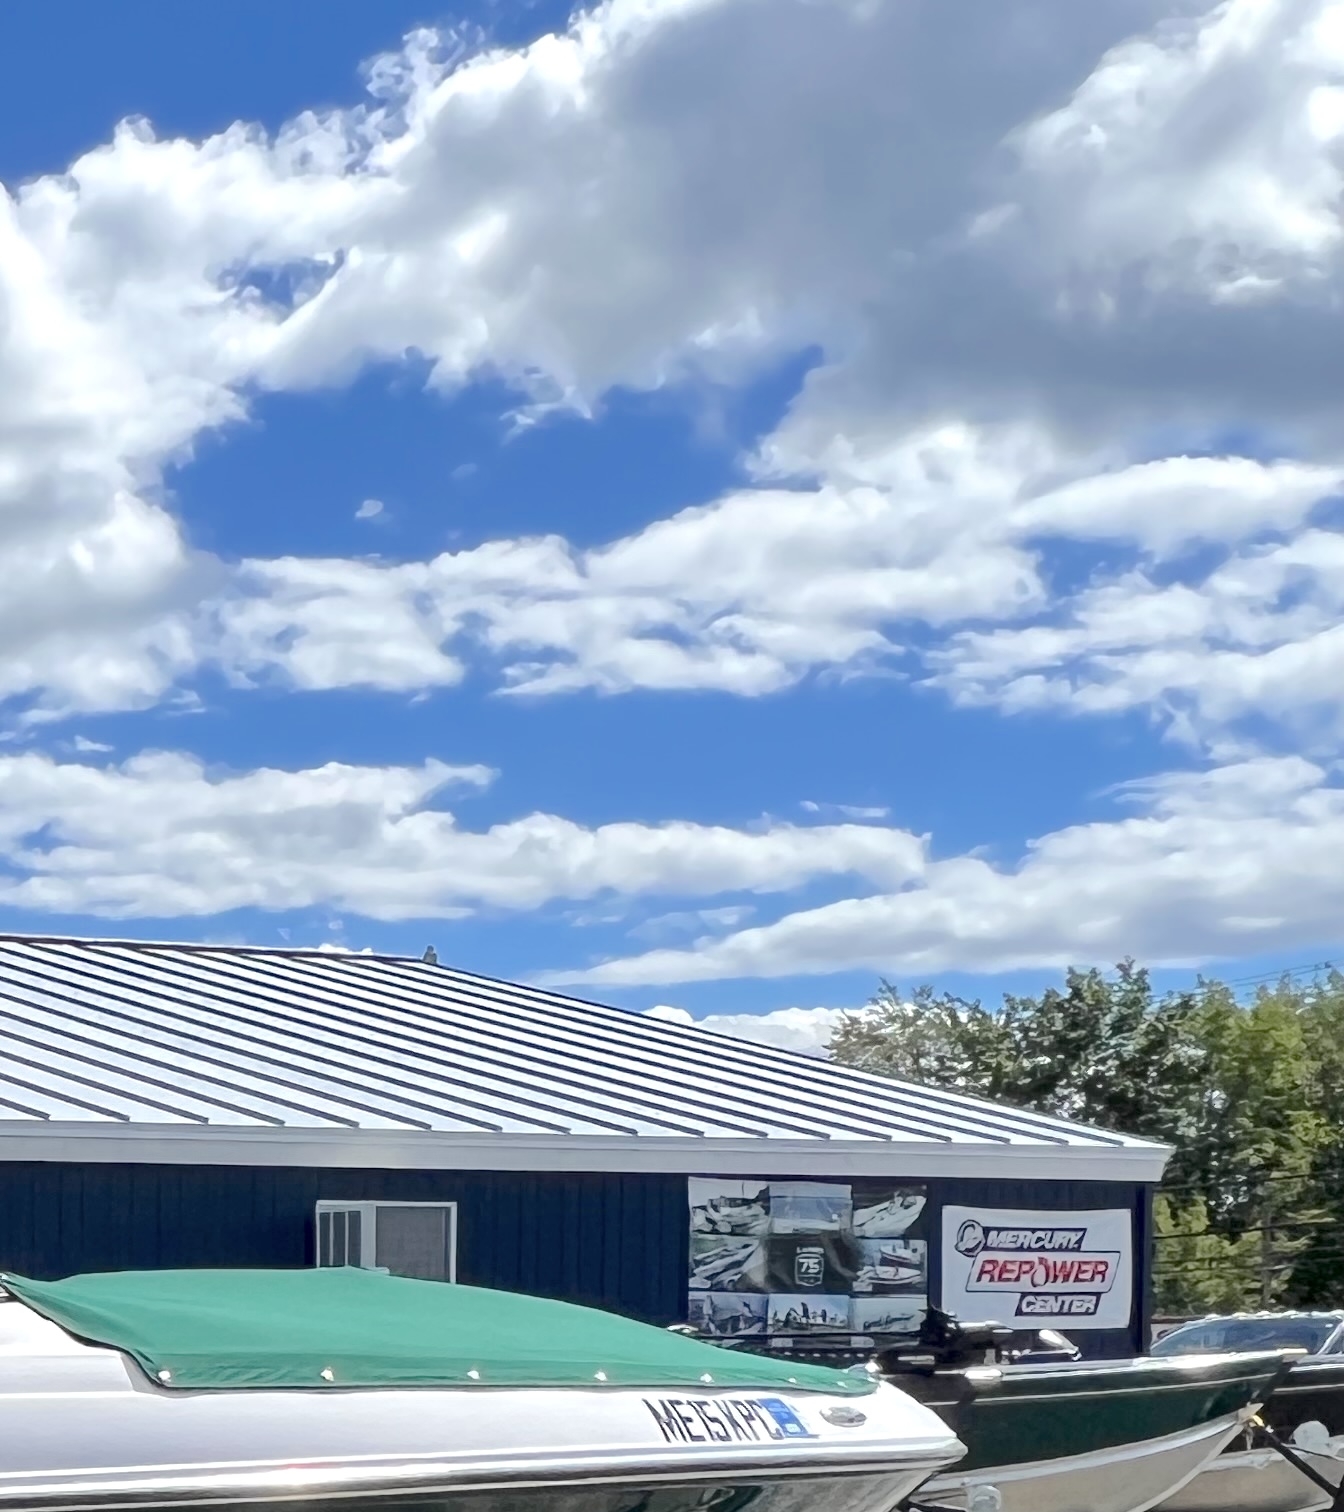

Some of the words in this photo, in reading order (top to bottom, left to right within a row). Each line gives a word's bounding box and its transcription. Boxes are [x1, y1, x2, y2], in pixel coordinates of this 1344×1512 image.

[986, 1231, 1084, 1249] MERCURY
[798, 1258, 820, 1274] 75
[976, 1257, 1109, 1287] REPOWER
[1021, 1295, 1097, 1313] CENTER
